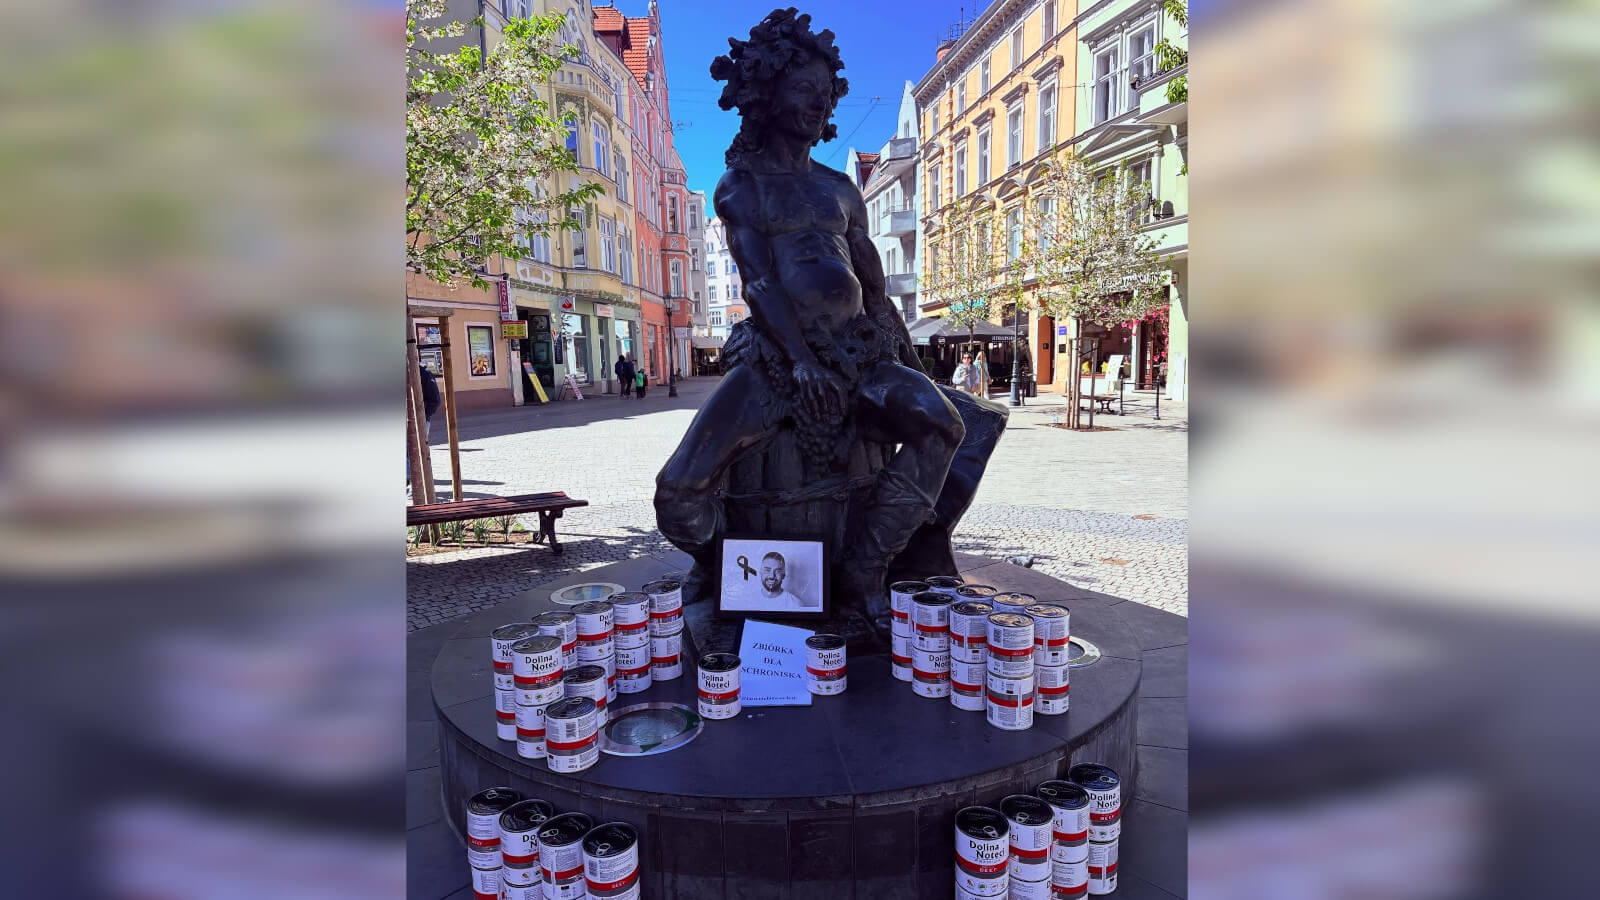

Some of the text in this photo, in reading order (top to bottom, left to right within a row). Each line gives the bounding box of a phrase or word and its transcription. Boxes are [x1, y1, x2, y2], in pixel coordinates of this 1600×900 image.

[525, 655, 553, 664] Dolina
[764, 657, 782, 666] DLA
[532, 659, 558, 671] Noteci
[702, 672, 723, 681] Dolina
[741, 666, 802, 679] SCHRONISKA
[706, 681, 730, 689] Noteci
[1090, 793, 1116, 801] Dolina
[969, 840, 1000, 851] Dolina
[976, 849, 1005, 860] Noteci
